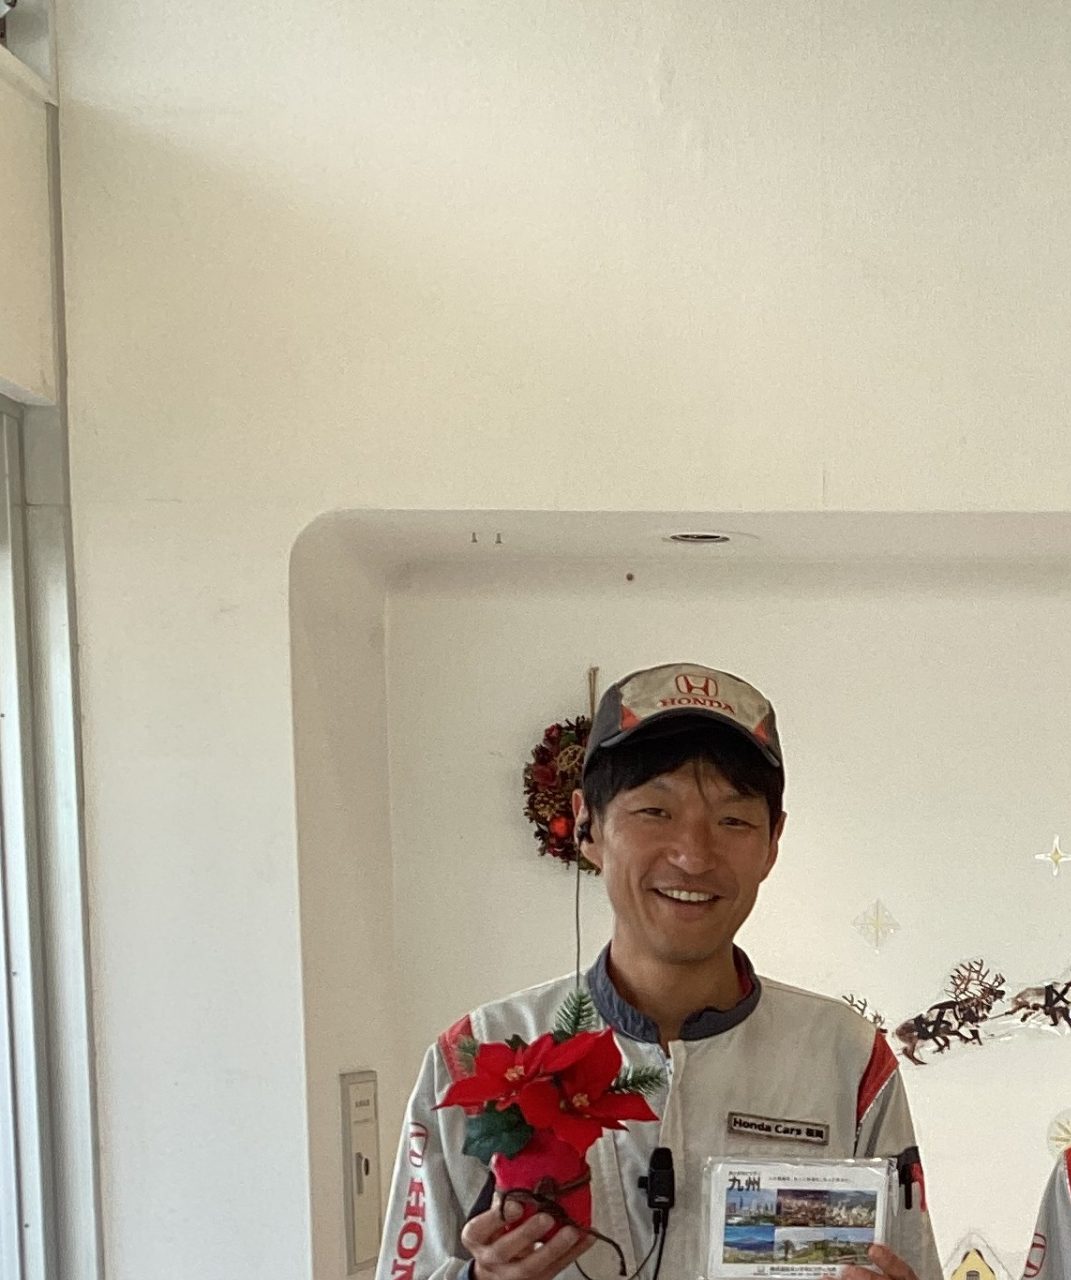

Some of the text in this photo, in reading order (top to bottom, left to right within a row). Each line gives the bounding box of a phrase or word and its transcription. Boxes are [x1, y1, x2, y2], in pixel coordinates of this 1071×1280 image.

[659, 697, 735, 716] HONDA
[733, 1117, 771, 1132] Honda
[774, 1124, 802, 1136] Cars
[728, 1176, 761, 1191] 九州
